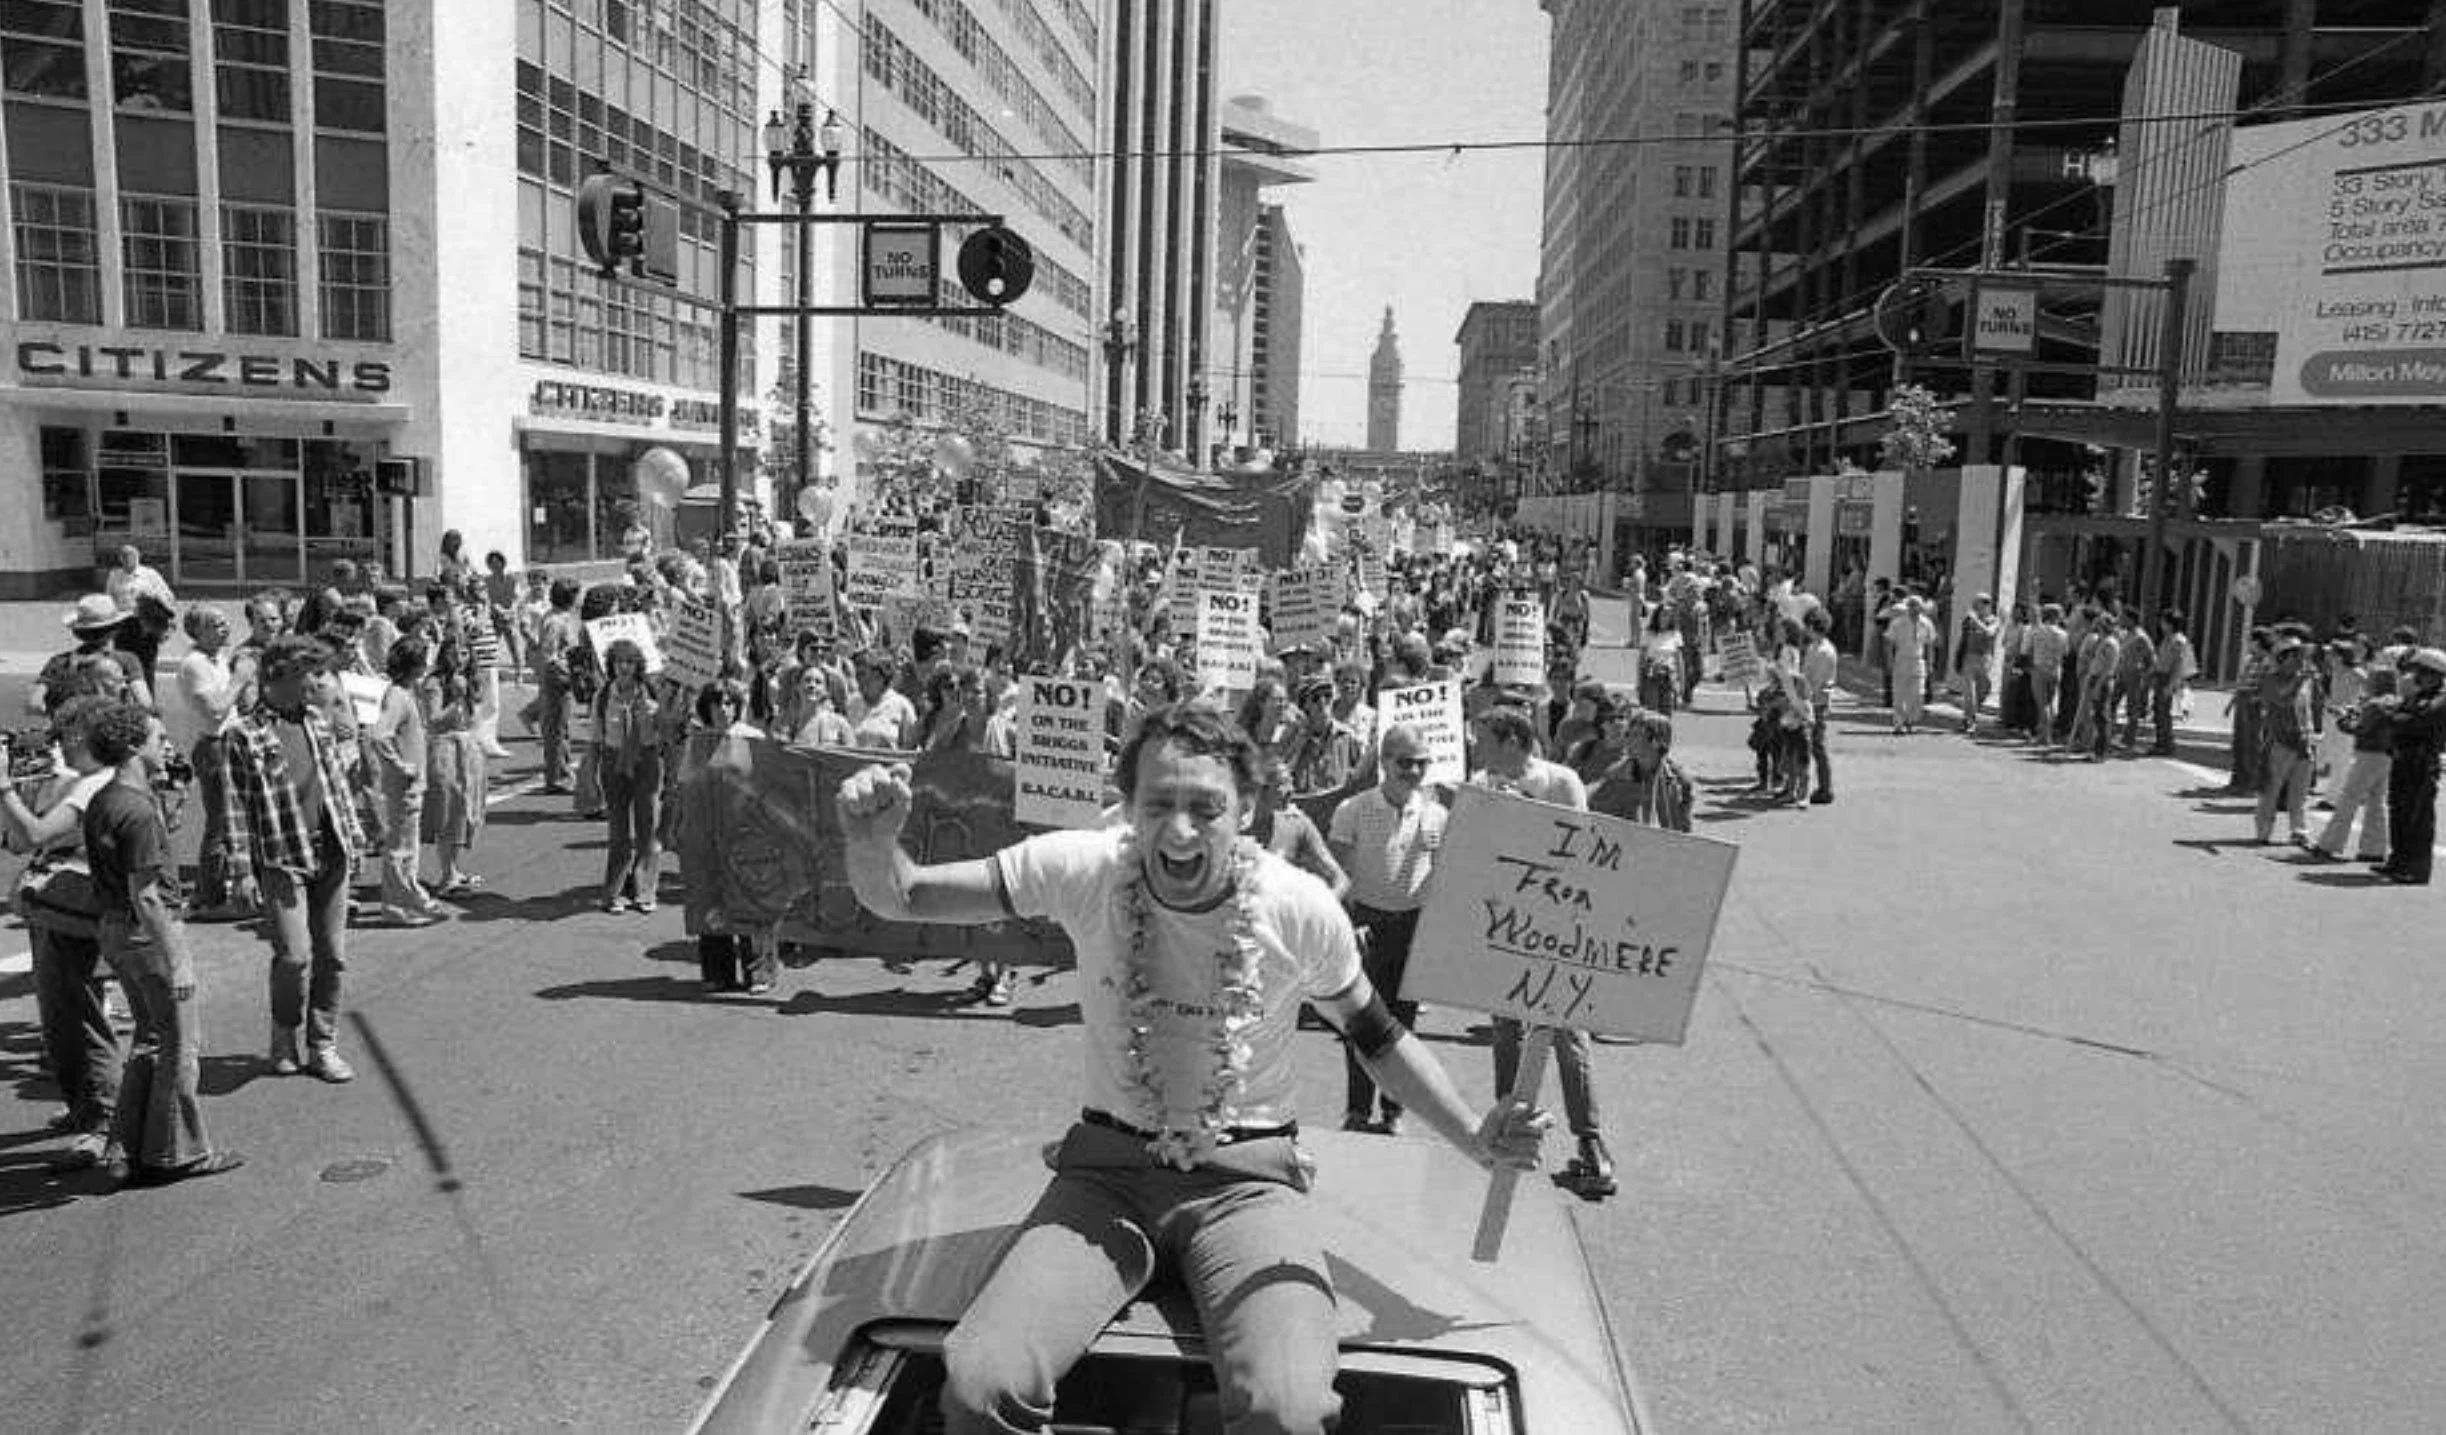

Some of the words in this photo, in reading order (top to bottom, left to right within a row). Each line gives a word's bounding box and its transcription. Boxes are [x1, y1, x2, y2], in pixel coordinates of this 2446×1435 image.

[2372, 169, 2434, 192] Story
[2353, 196, 2411, 217] Story
[2329, 218, 2376, 240] Total
[886, 251, 912, 264] NO
[873, 265, 930, 280] TURNS
[1992, 307, 2017, 320] NO
[17, 341, 392, 392] CITIZENS
[1210, 595, 1249, 612] NO!
[1505, 603, 1537, 618] NO!
[1033, 682, 1091, 711] NO!
[1395, 685, 1447, 708] NO!
[1031, 715, 1054, 728] ON
[1058, 717, 1089, 732] THE
[1547, 820, 1622, 871] I'M
[1506, 965, 1594, 1019] N.Y.
